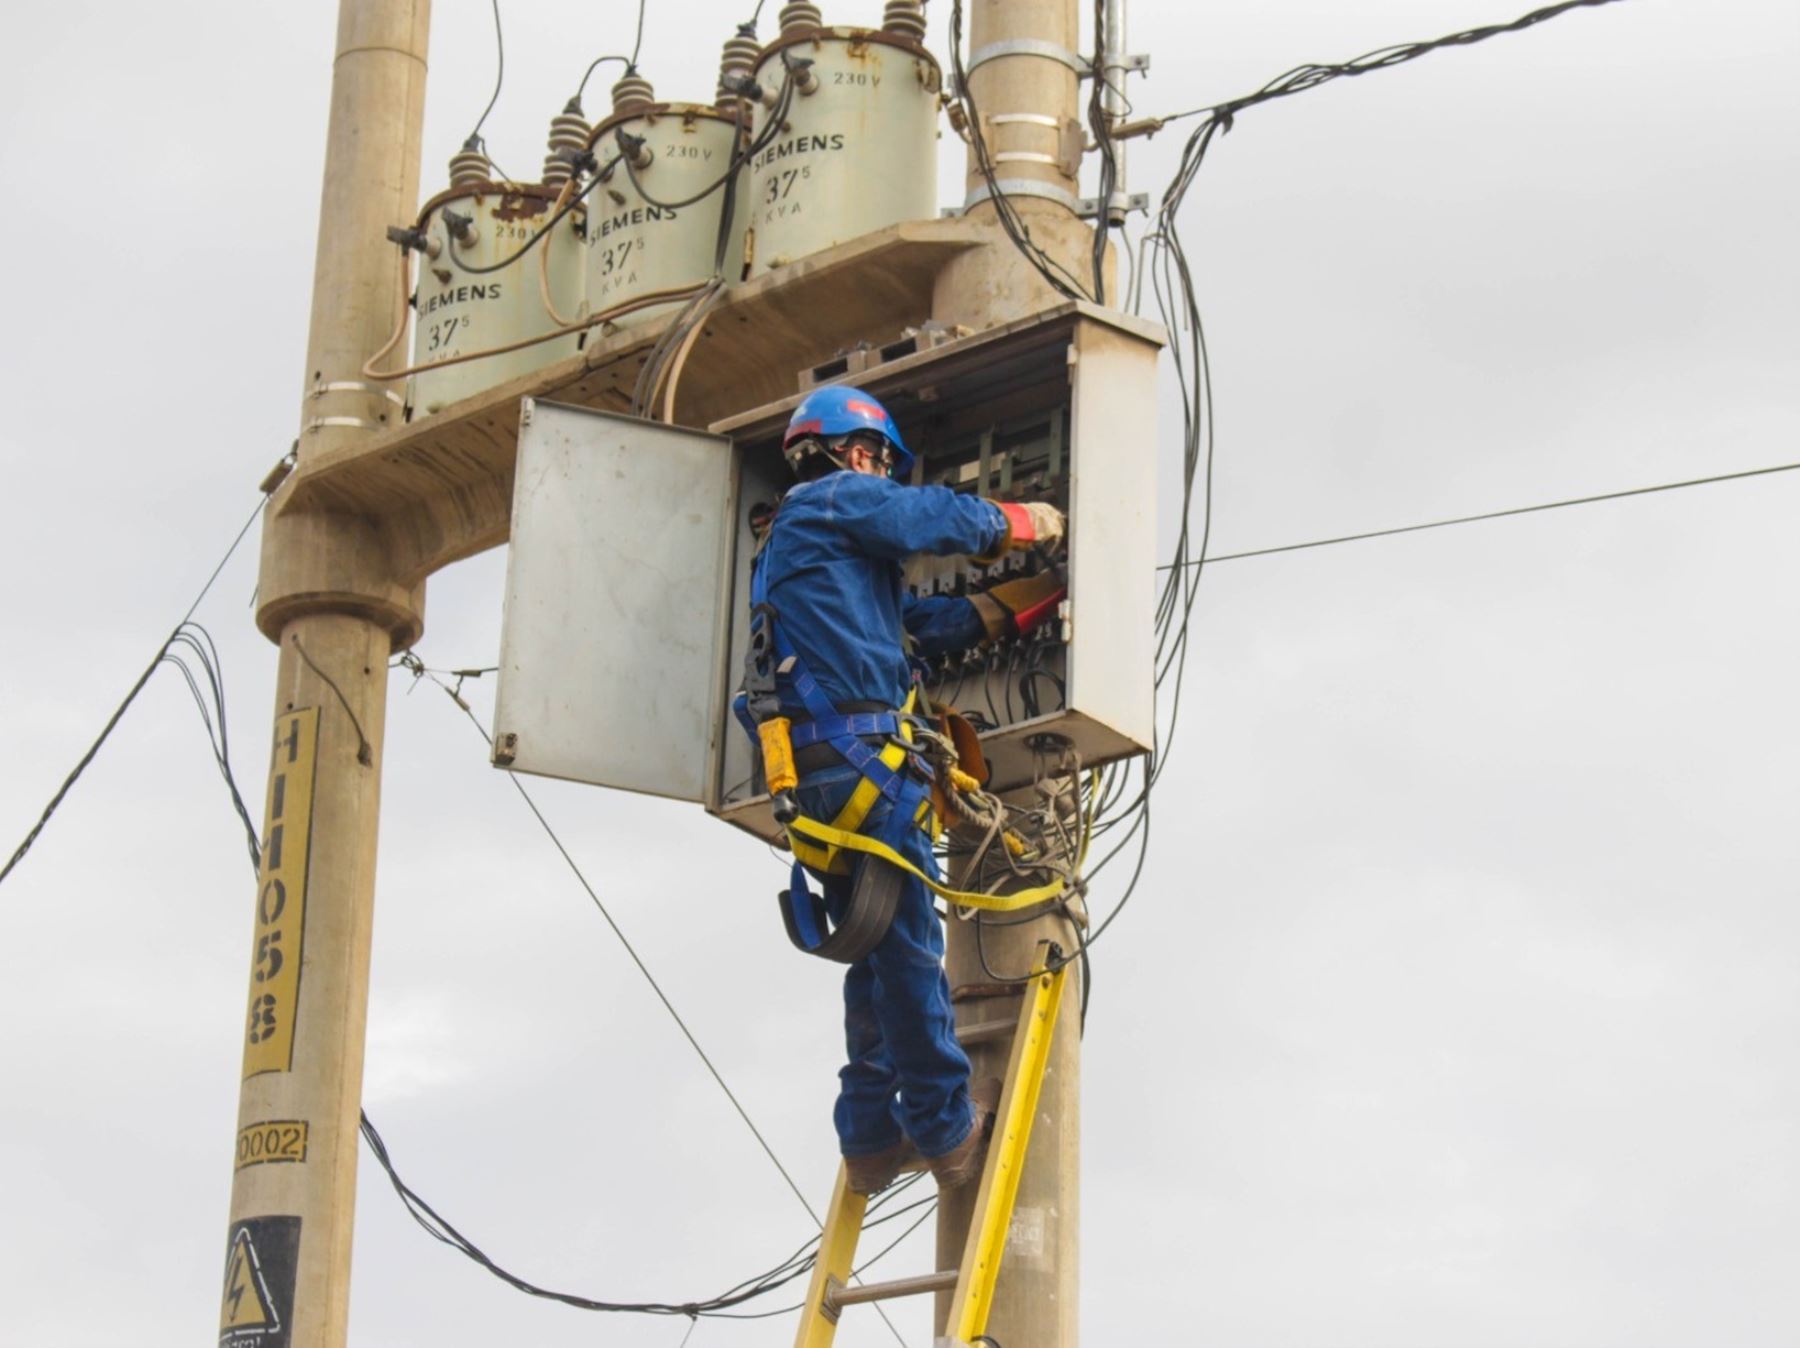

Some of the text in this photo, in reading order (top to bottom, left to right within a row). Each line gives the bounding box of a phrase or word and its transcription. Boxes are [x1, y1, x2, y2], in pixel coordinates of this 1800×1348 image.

[754, 134, 845, 174] SIEMENS
[589, 206, 678, 249] SIEMENS
[418, 283, 502, 321] SIEMENS
